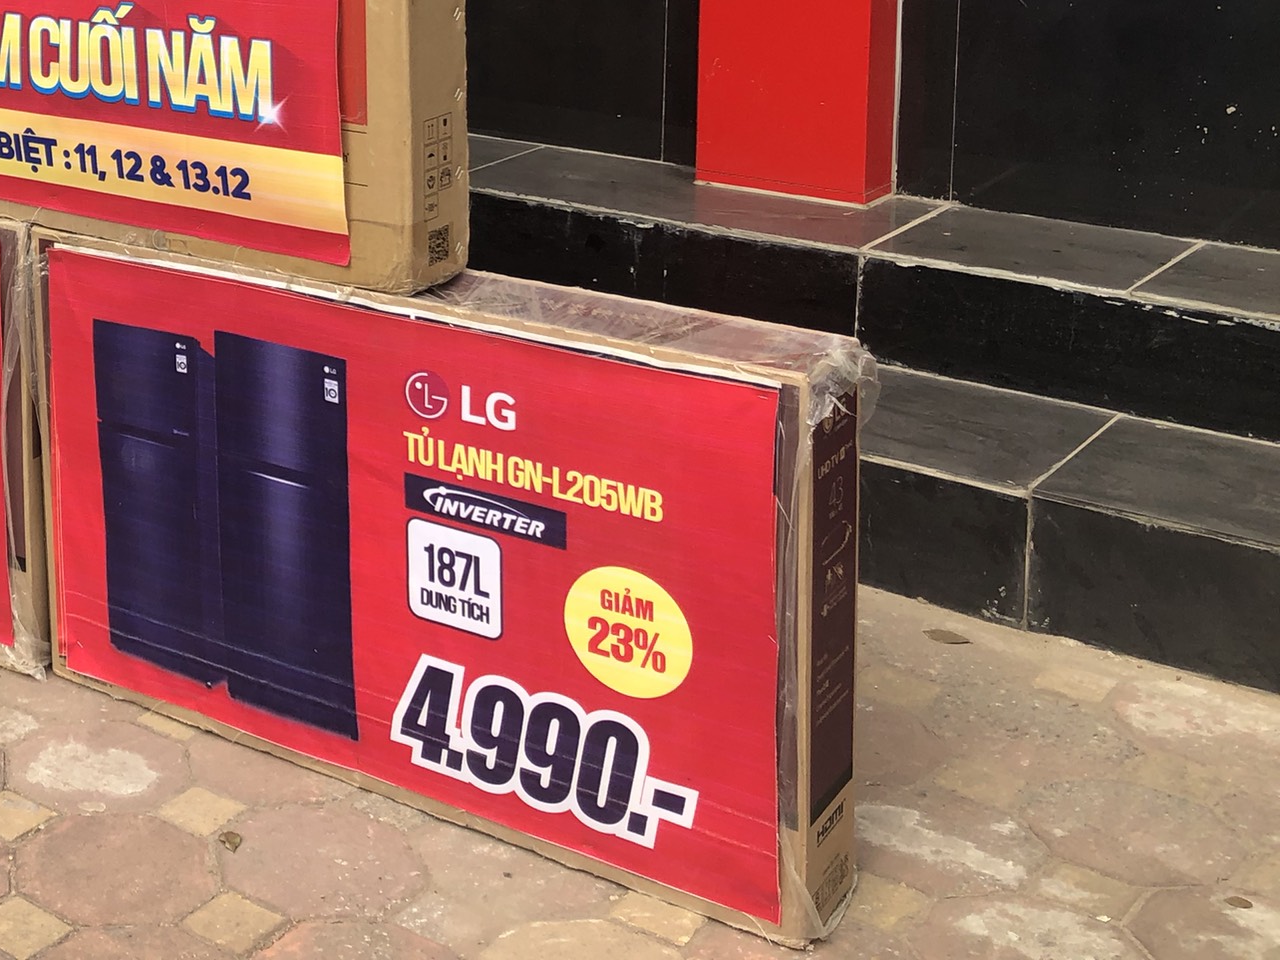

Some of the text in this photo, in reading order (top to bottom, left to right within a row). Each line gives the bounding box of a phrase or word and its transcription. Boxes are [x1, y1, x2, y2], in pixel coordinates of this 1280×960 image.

[28, 1, 141, 106] CUỐI
[146, 14, 275, 123] NĂM
[75, 143, 107, 181] 11,
[117, 149, 144, 181] 12
[149, 153, 173, 187] &
[176, 161, 252, 201] 13.12
[460, 385, 517, 431] LG
[403, 427, 664, 523] TỦ LẠNH GN-L205WB
[423, 486, 546, 539] INVERTER
[424, 543, 490, 599] 187L
[420, 587, 490, 624] DUNG TÍCH
[600, 587, 654, 623] GIẢM
[587, 616, 666, 674] 23%
